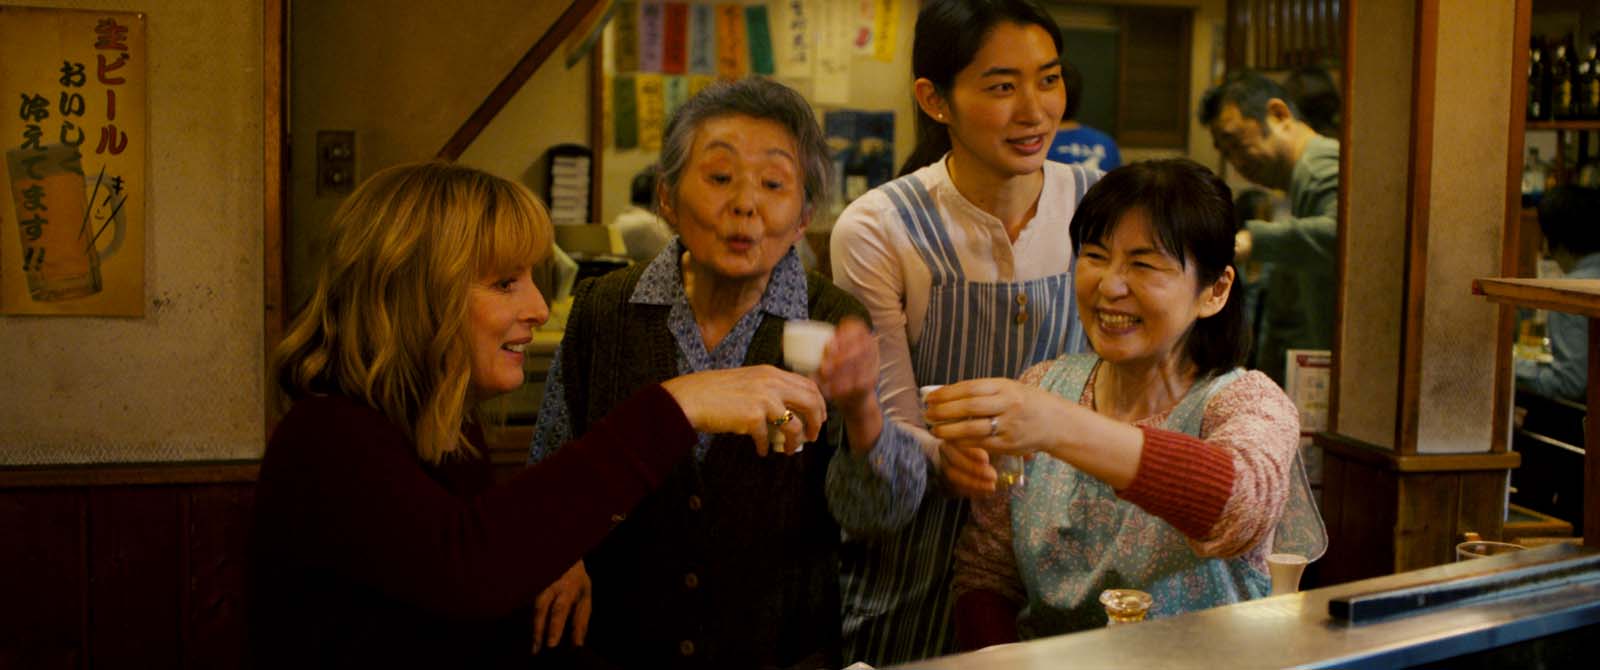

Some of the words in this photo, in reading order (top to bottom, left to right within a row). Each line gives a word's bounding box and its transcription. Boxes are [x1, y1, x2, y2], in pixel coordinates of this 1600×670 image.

[59, 60, 86, 175] おいしく
[95, 17, 129, 155] 生ビール
